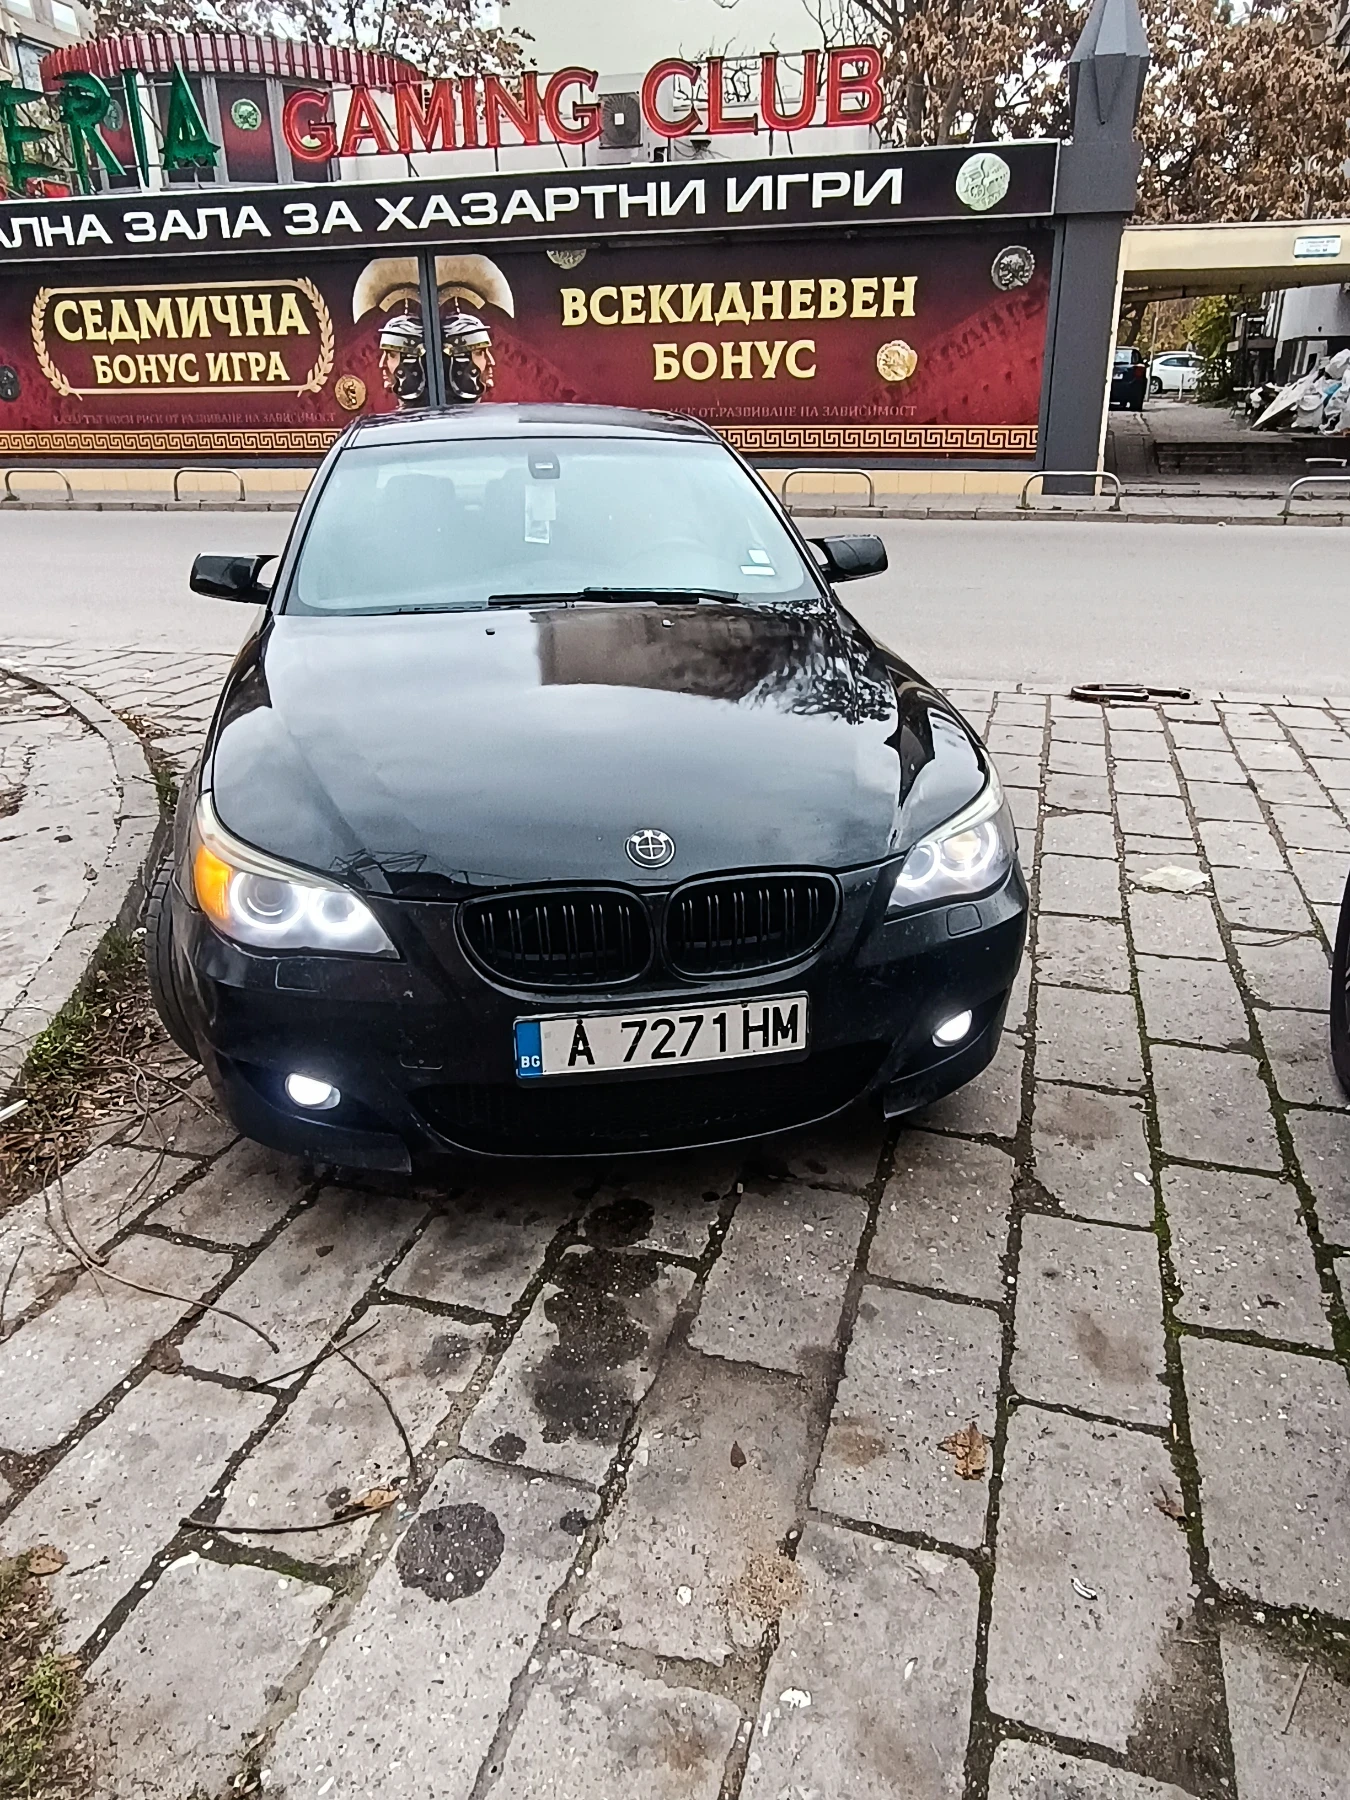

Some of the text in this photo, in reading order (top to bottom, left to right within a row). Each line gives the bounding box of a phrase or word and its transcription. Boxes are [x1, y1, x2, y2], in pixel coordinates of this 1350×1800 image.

[282, 45, 884, 162] GAMING CLUB
[123, 204, 271, 243] ЗАЛА
[283, 201, 362, 235] ЗА
[377, 179, 705, 231] ХАЗАРТНИ
[727, 167, 904, 214] ИГРИ
[54, 293, 310, 345] СЕДМИЧНА
[560, 276, 918, 327] ВСЕКИДНЕВЕН
[92, 351, 290, 384] БОНУС ИГРА
[652, 340, 817, 381] БОНУС
[800, 406, 819, 417] НА
[822, 405, 917, 417] ЗАВИСИМОСТ
[520, 1055, 541, 1068] BG
[620, 1012, 727, 1063] 7271
